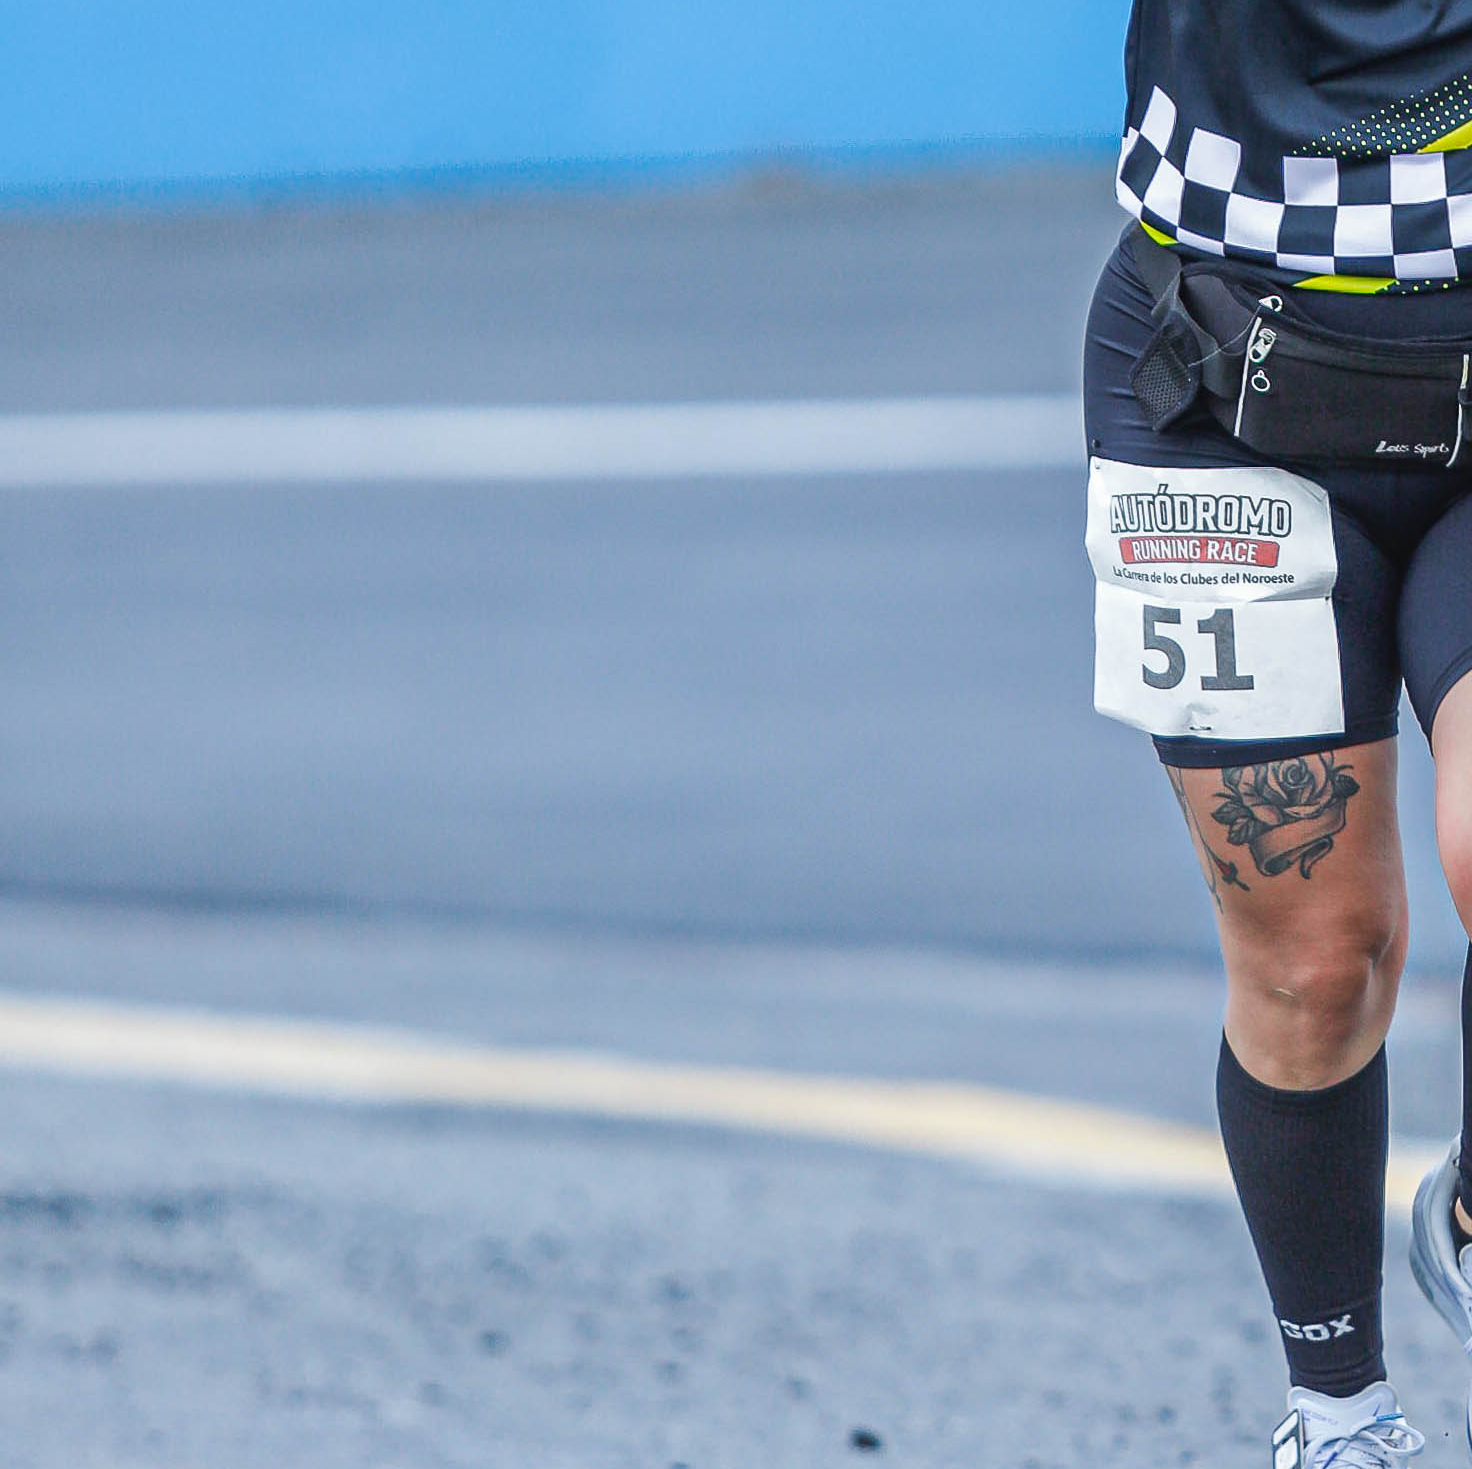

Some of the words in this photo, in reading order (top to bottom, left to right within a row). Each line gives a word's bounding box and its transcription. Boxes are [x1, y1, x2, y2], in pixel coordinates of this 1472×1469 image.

[1110, 483, 1292, 538] AUTÓDROMO
[1131, 539, 1201, 561] RUNNING
[1207, 539, 1258, 564] RACE
[1113, 565, 1122, 578] La
[1122, 567, 1149, 582] Carrera
[1150, 571, 1161, 584] de
[1163, 571, 1178, 584] los
[1180, 572, 1218, 585] Clubes
[1221, 572, 1240, 584] del
[1242, 572, 1295, 584] Noroeste
[1142, 604, 1255, 691] 51
